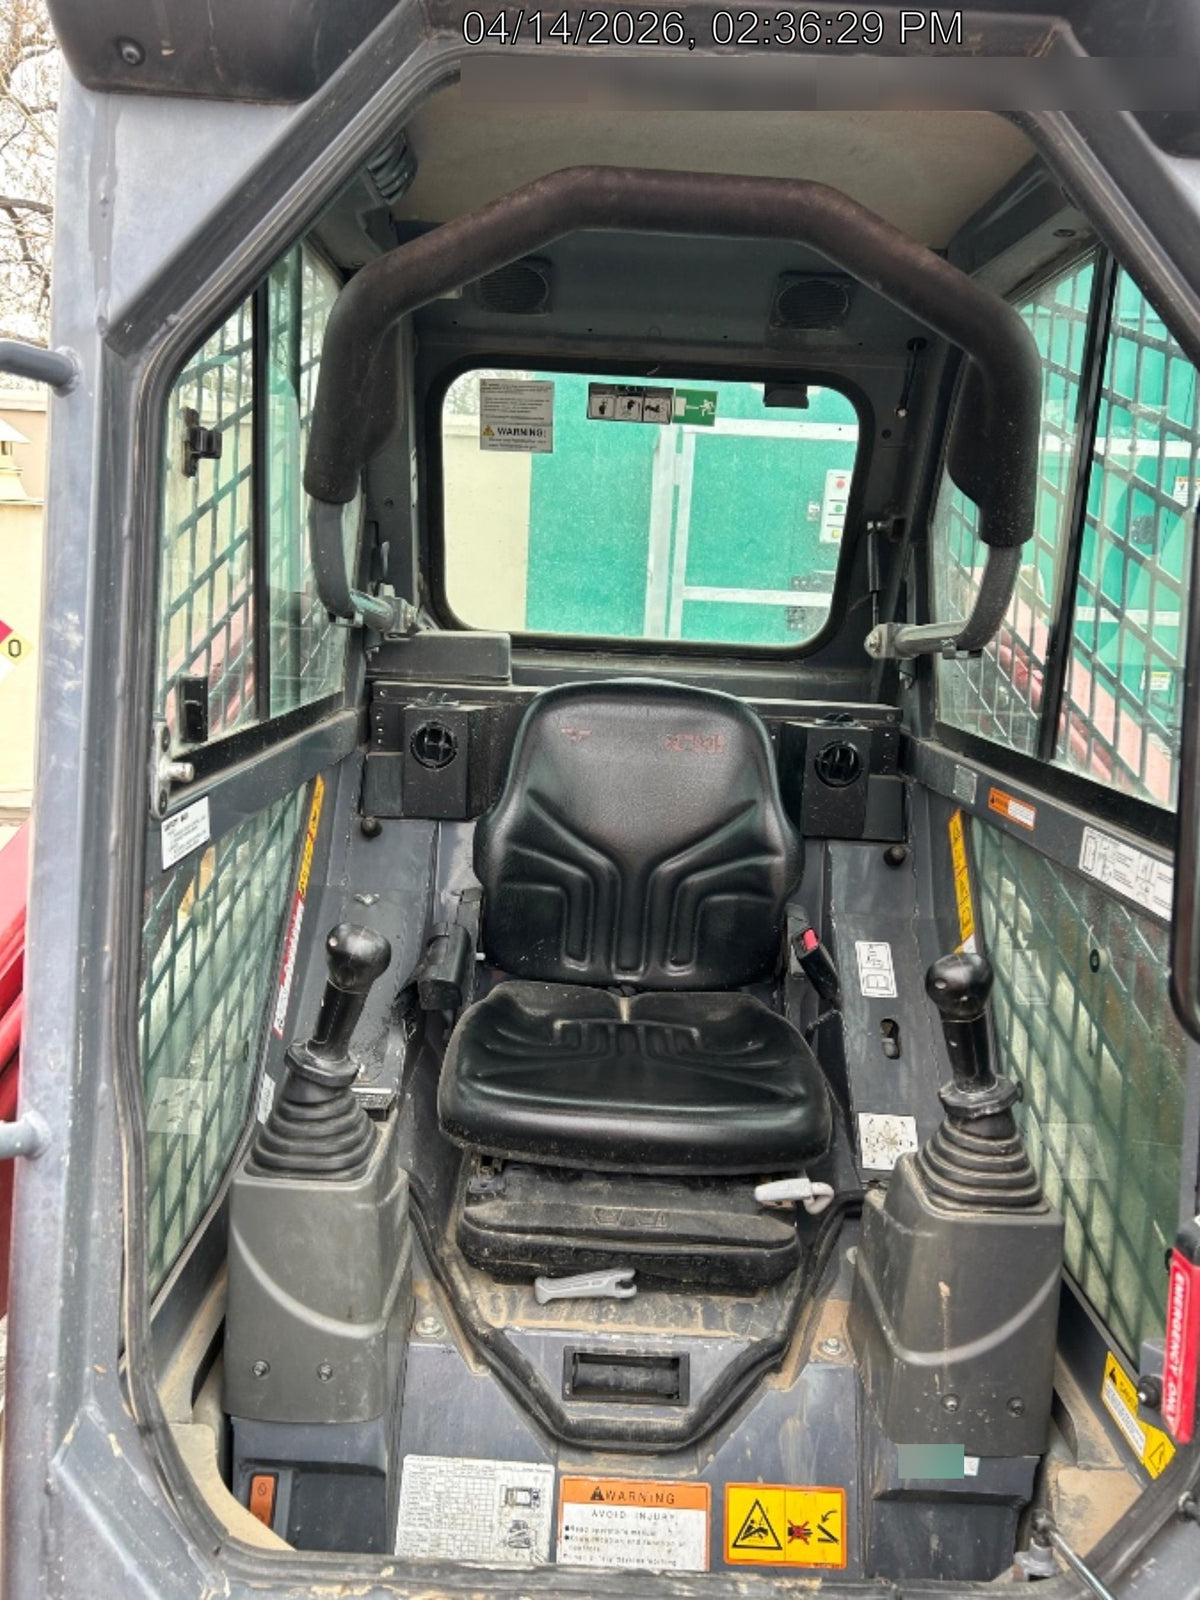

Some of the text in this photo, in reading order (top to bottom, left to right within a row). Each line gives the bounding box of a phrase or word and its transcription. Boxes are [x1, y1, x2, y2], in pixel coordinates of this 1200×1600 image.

[8, 638, 22, 658] 0
[1165, 1271, 1185, 1424] EMERGENCY ONLY
[606, 1489, 675, 1505] WARNING
[592, 1508, 675, 1521] AVOID INJURY
